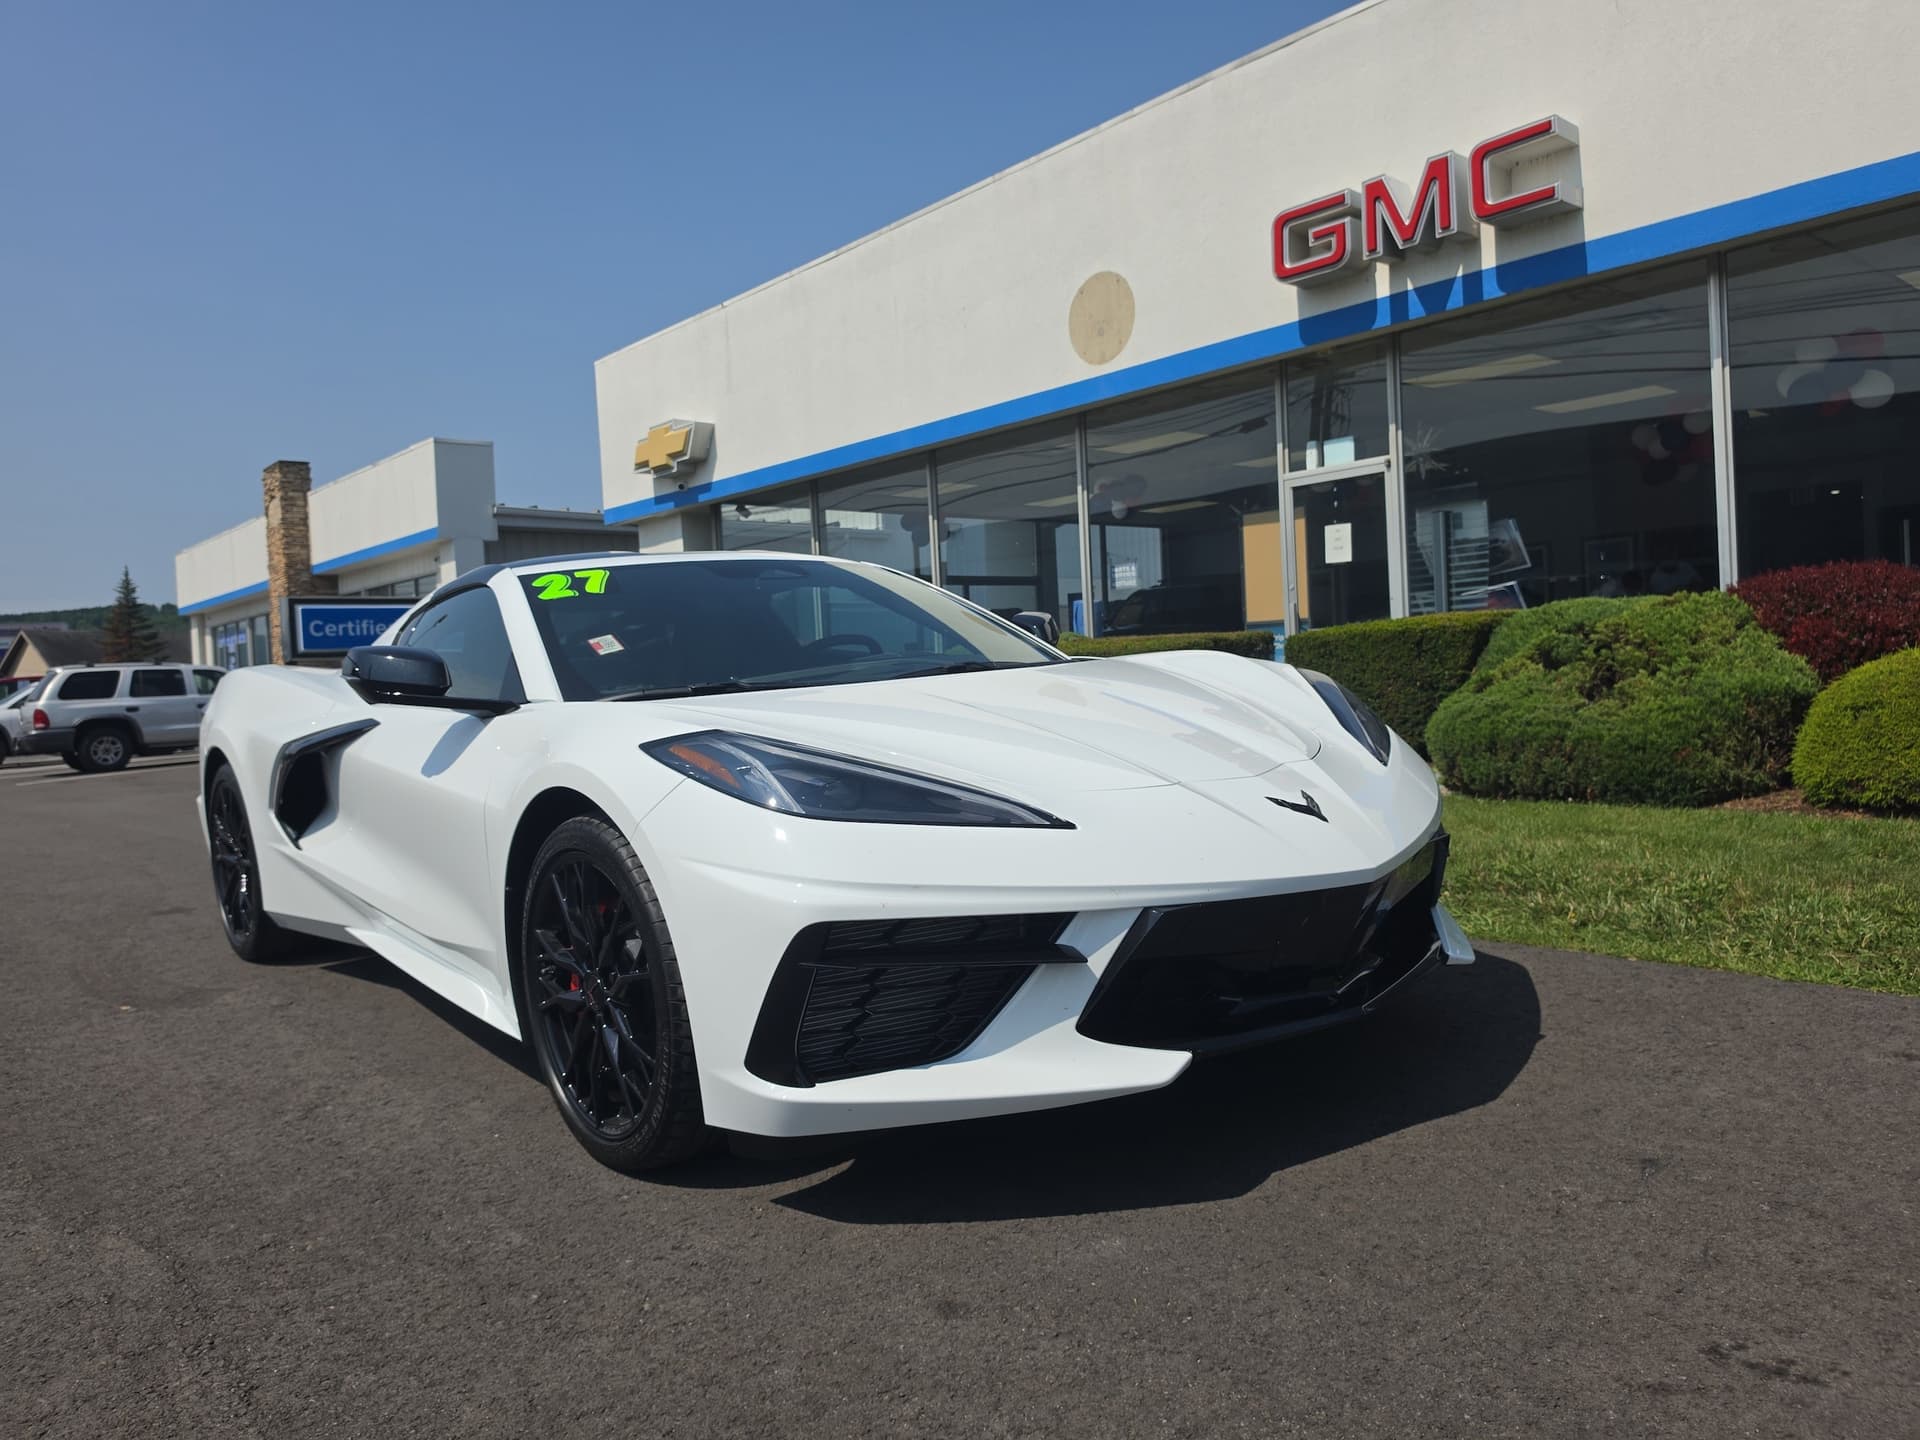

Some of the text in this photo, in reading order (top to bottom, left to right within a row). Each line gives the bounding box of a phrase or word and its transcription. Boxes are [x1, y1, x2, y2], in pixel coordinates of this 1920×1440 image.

[1271, 114, 1563, 285] GMC
[531, 569, 610, 600] 27
[309, 619, 391, 638] Certifie
